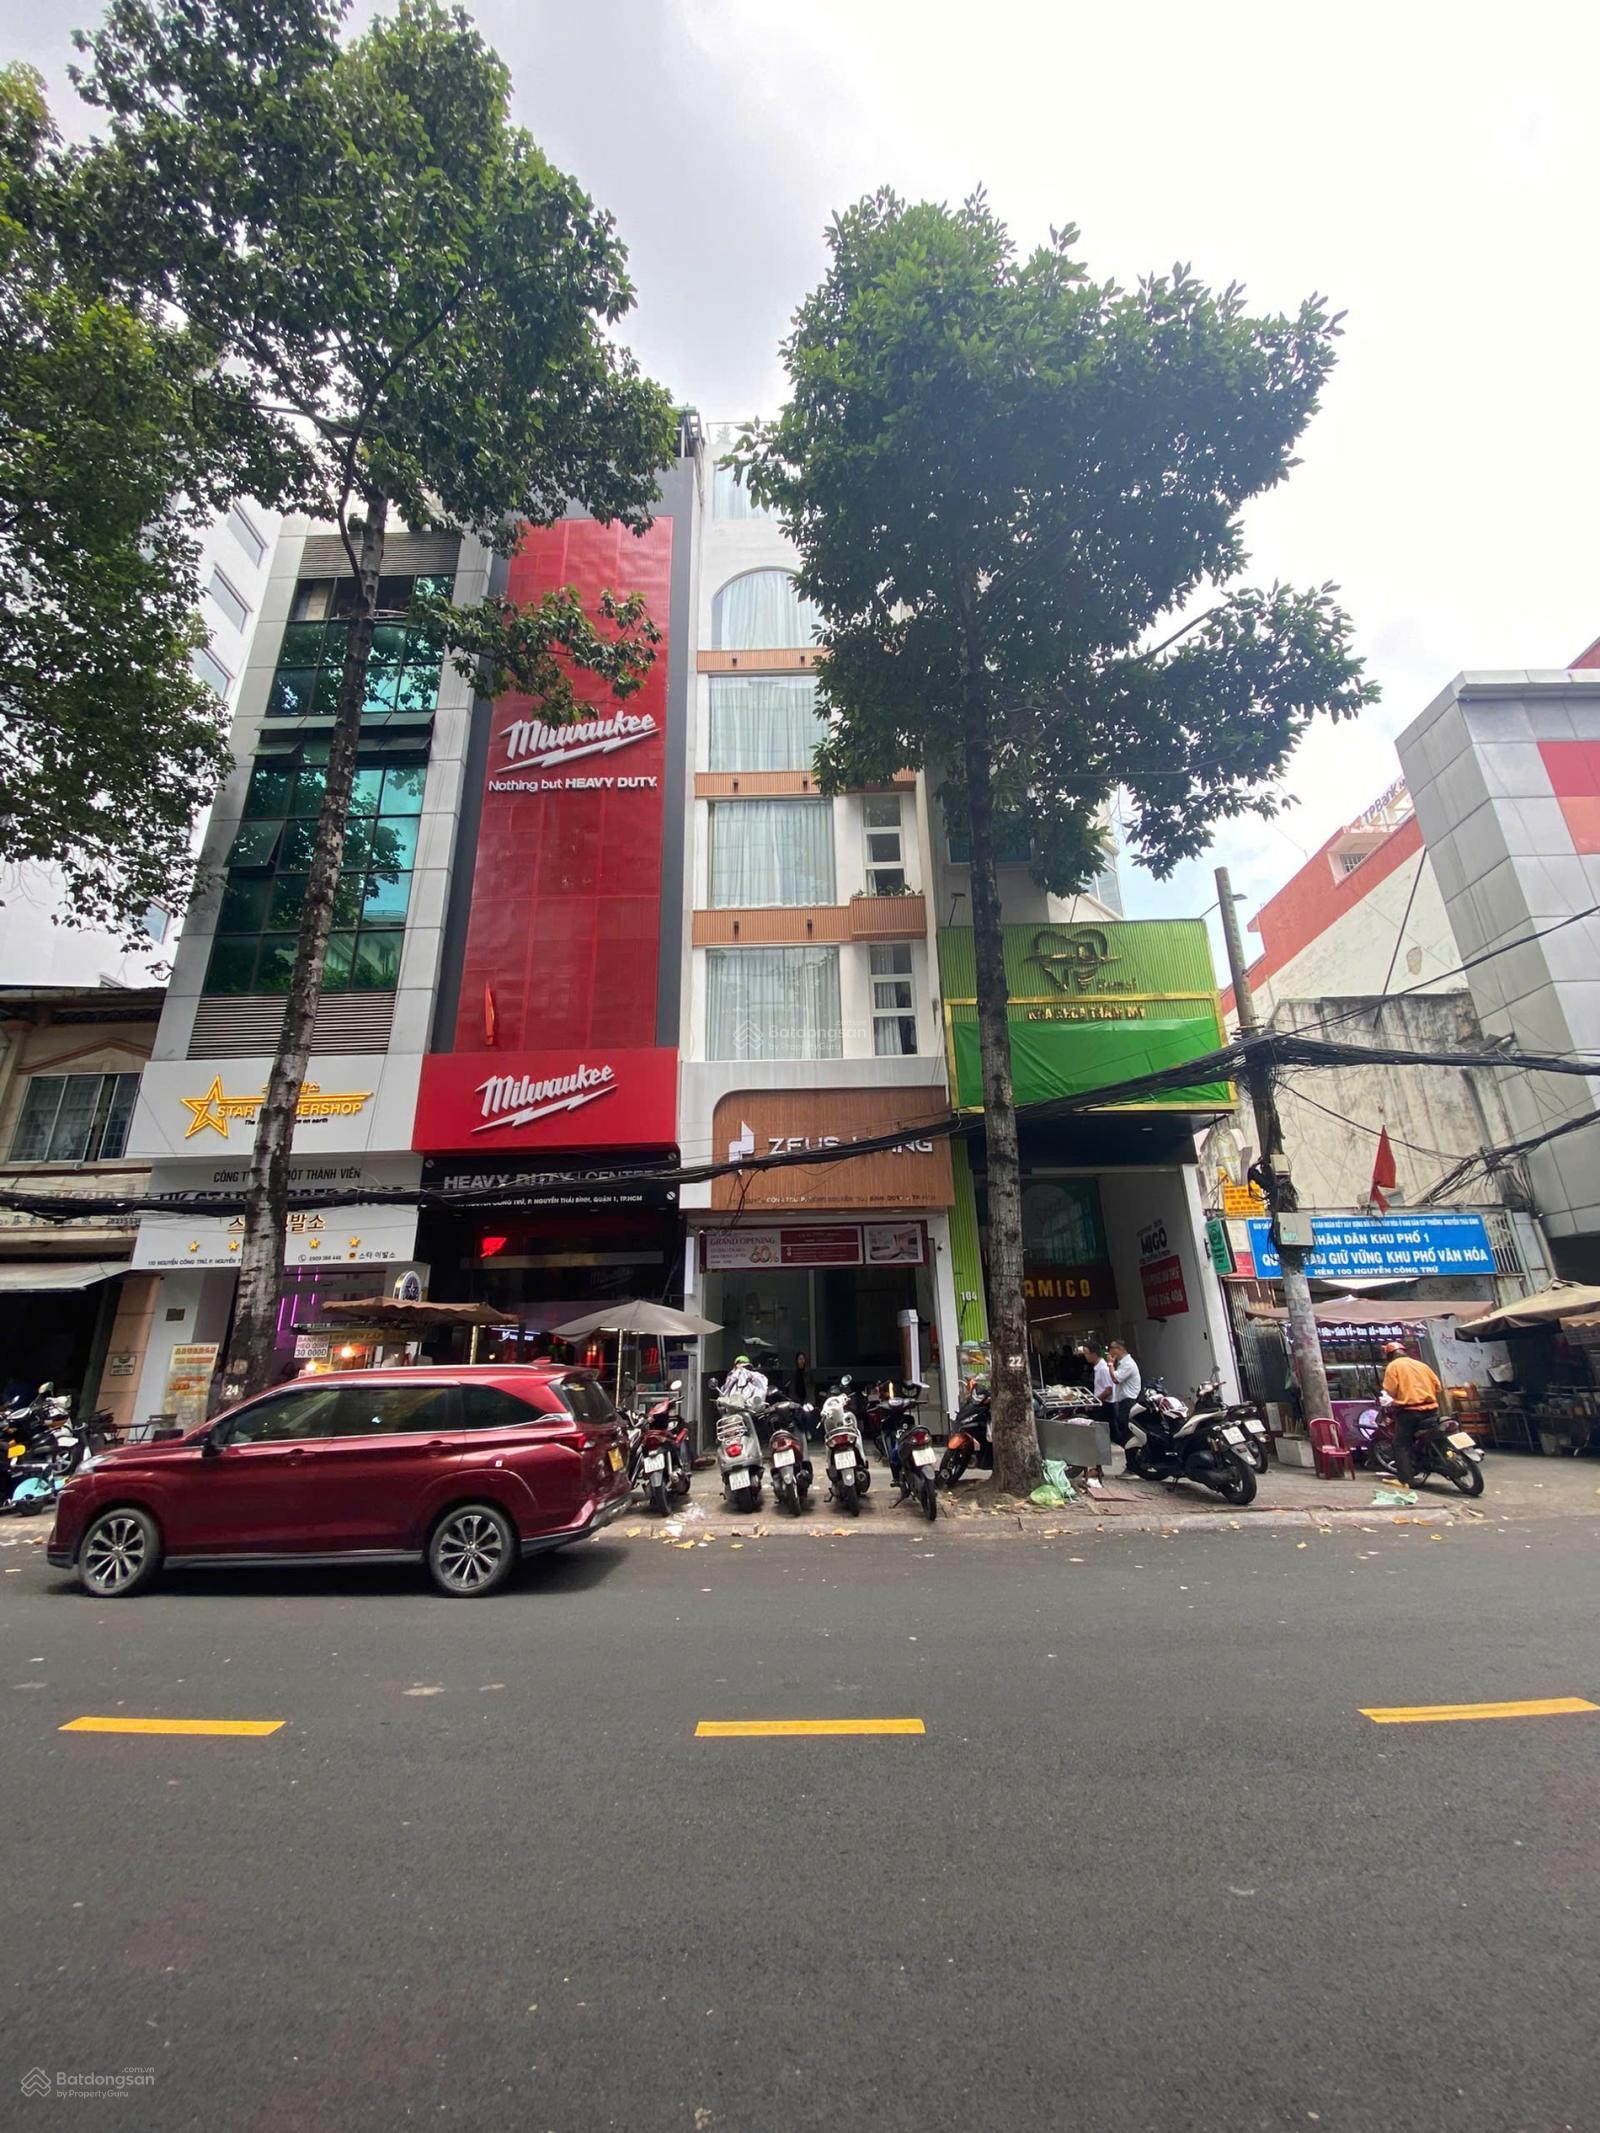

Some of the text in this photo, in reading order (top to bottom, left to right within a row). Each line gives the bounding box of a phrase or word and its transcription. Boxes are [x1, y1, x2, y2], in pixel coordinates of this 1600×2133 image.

[497, 710, 656, 760] Milwaukee
[489, 780, 538, 792] Nothing
[541, 779, 563, 790] but
[565, 777, 614, 789] HEAVY
[474, 1064, 615, 1117] Milwaukee
[216, 1102, 362, 1118] STAR ERSHOP
[214, 1169, 239, 1183] CÔNG
[443, 1173, 511, 1190] HEAVY
[1344, 1232, 1368, 1245] DÂN
[1371, 1232, 1394, 1244] KHU
[1397, 1230, 1421, 1244] PHỐ
[1424, 1233, 1430, 1242] 1
[1329, 1249, 1349, 1265] GIỮ
[1351, 1248, 1383, 1264] VỮNG
[1386, 1250, 1411, 1263] KHU
[1413, 1247, 1437, 1263] PHỐ
[1437, 1247, 1462, 1263] VĂN
[1463, 1246, 1489, 1262] HÓA
[1337, 1267, 1352, 1275] 100
[1393, 1265, 1419, 1274] CÔNG
[961, 1291, 978, 1301] 104
[1009, 1356, 1022, 1367] 22
[225, 1385, 239, 1396] 24
